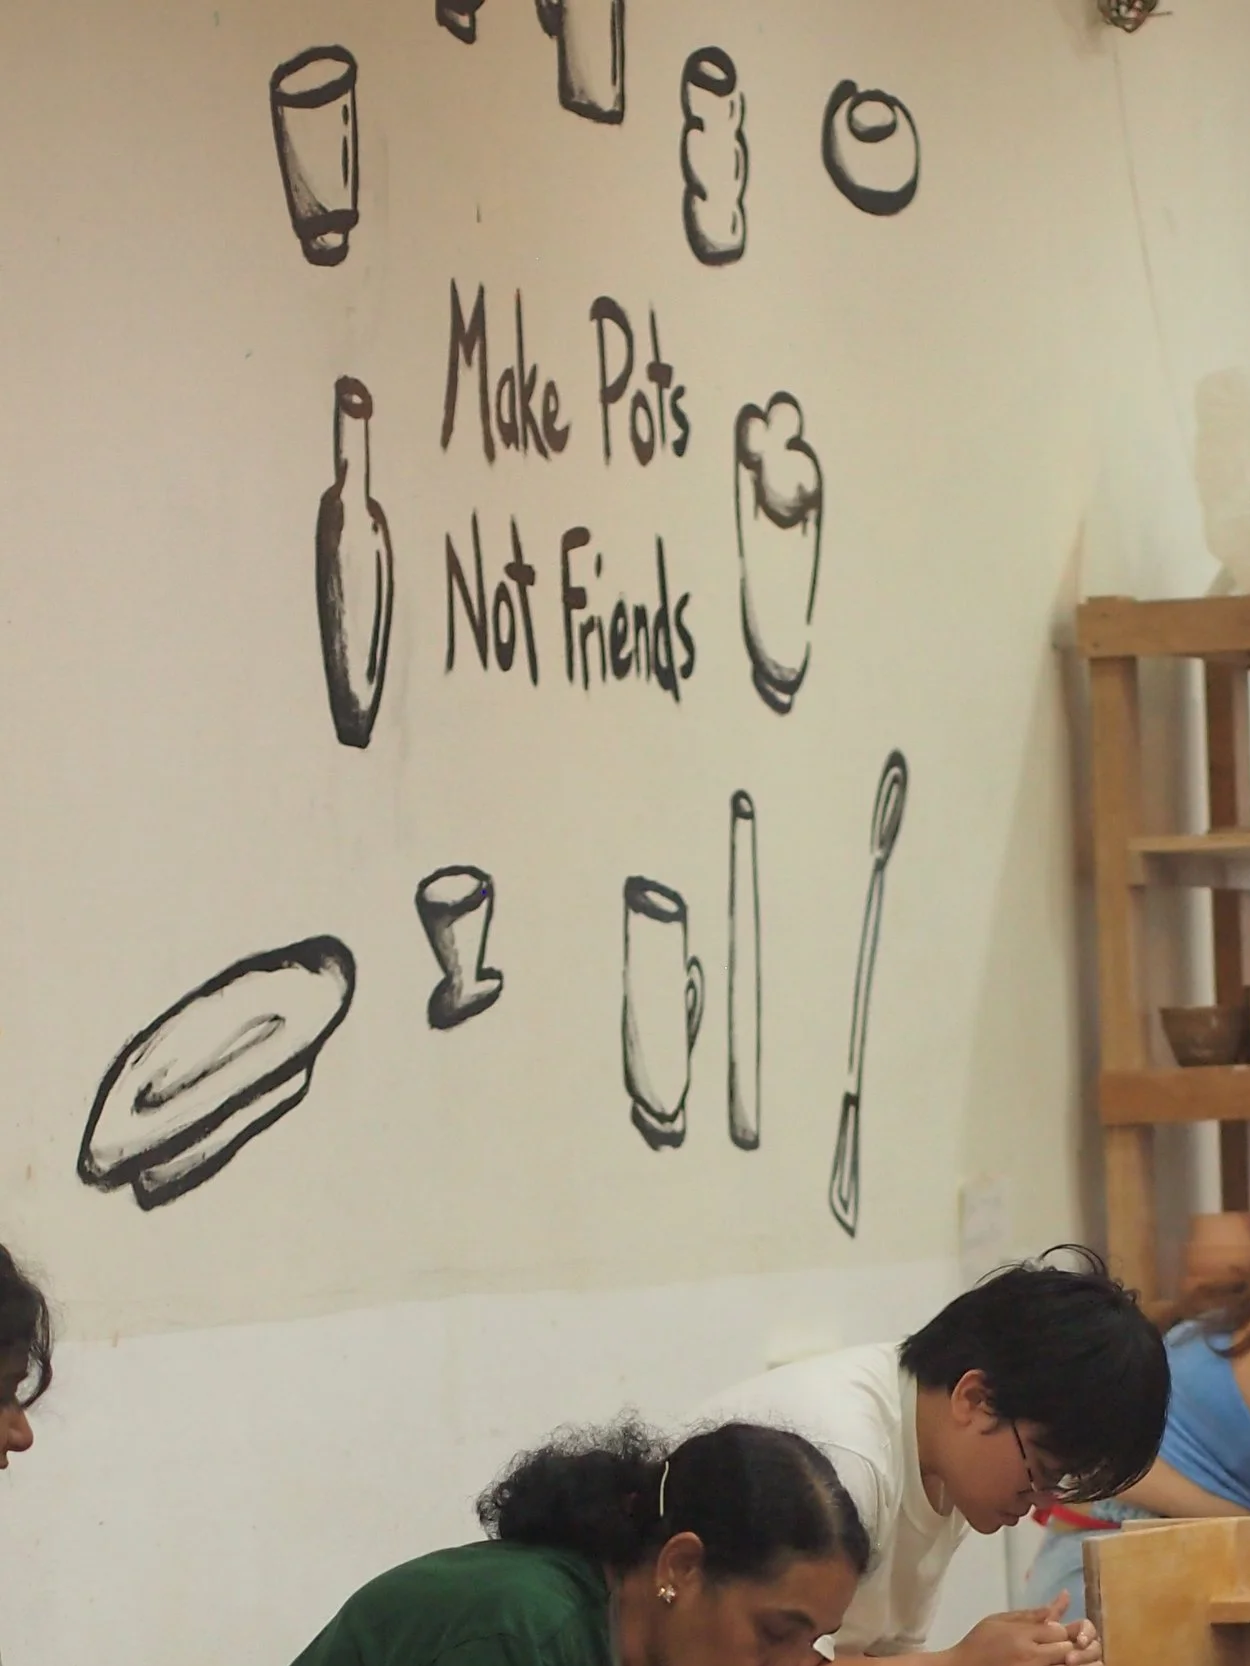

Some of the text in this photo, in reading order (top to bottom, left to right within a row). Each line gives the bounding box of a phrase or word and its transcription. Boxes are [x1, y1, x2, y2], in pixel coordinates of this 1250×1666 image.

[441, 277, 690, 467] Make Pots
[443, 508, 695, 704] Not Friends
